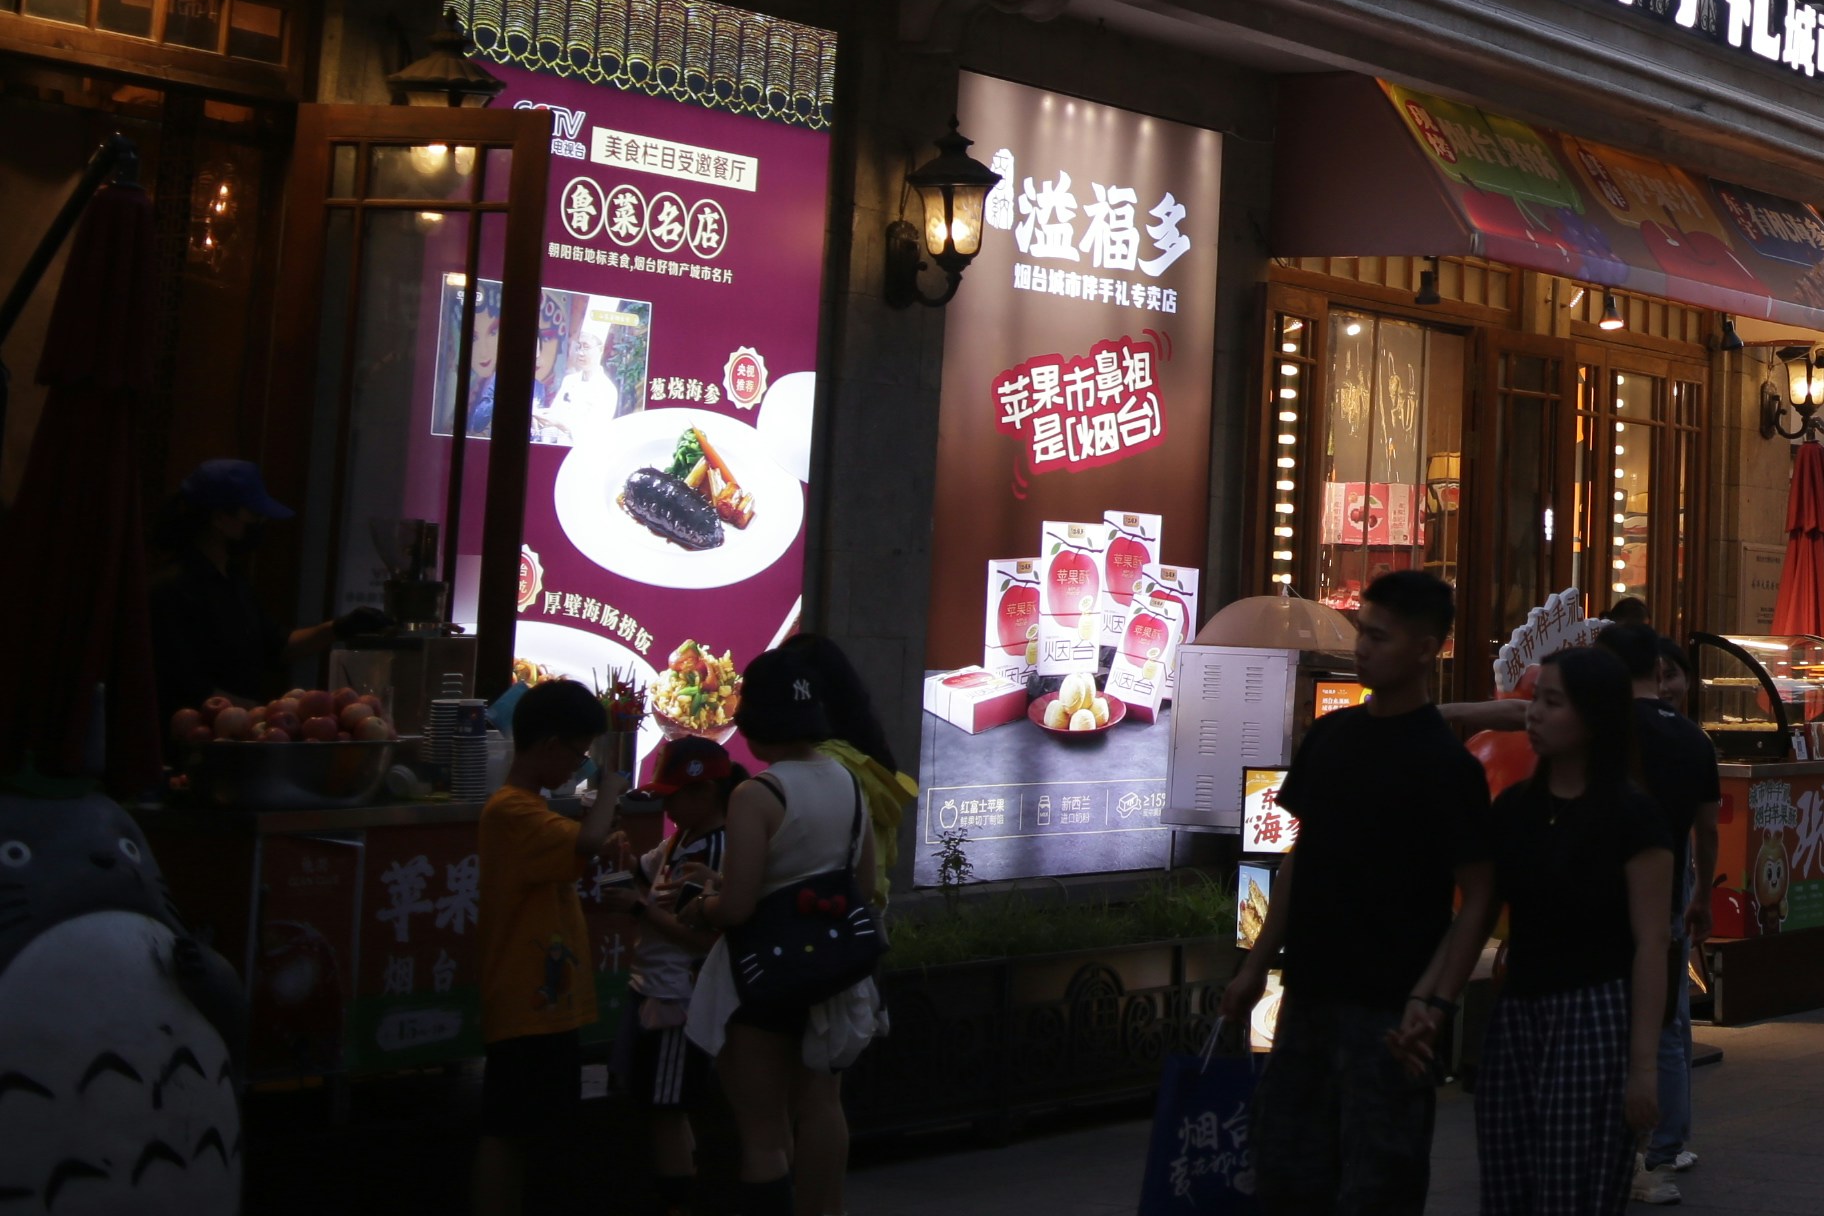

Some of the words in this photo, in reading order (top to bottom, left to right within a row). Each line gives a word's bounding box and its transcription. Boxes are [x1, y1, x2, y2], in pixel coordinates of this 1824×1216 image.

[604, 134, 747, 184] 美食栏目受邀餐厅
[567, 184, 719, 250] 鲁菜名店
[1015, 170, 1191, 277] 溢福多
[1014, 262, 1178, 314] 烟台城市伴手礼专卖店
[737, 363, 756, 377] 央视
[649, 377, 721, 405] 葱烧海参
[735, 378, 756, 393] 推荐
[997, 346, 1153, 429] 苹果市鼻祖
[542, 590, 655, 655] 厚壁海肠捞饭
[1044, 639, 1095, 662] 烟台
[1506, 594, 1584, 683] 城市伴手礼
[792, 679, 811, 701] NY
[1111, 670, 1155, 696] 烟台
[960, 798, 1005, 815] 红富士苹果
[1061, 796, 1091, 811] 新西兰
[1060, 813, 1090, 825] 进口奶粉
[375, 853, 481, 944] 苹果
